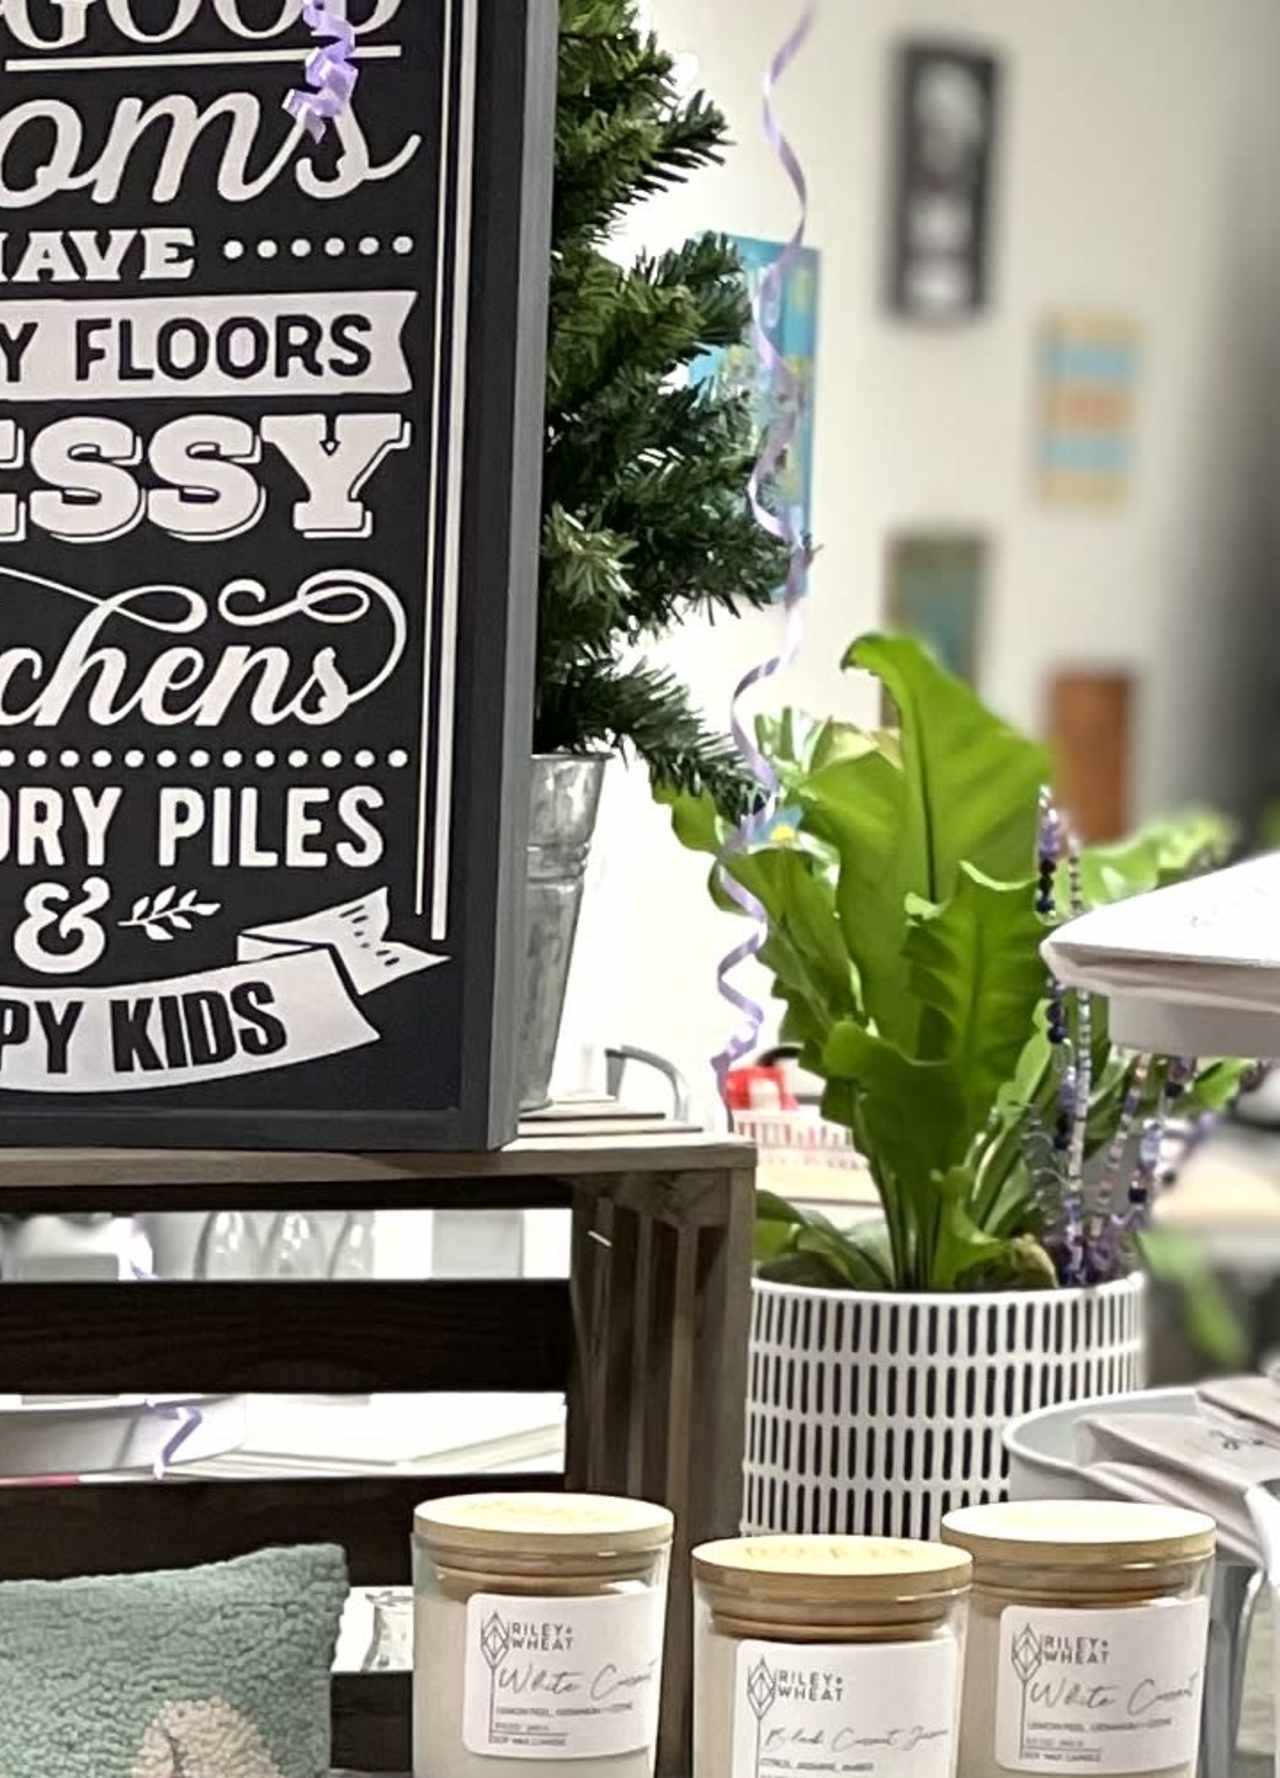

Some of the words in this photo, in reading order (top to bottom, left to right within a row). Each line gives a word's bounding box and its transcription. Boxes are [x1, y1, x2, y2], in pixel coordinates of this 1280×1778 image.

[74, 314, 372, 383] FLOORS
[157, 785, 385, 867] PILES
[13, 877, 111, 974] &
[110, 979, 288, 1073] KIDS
[511, 1636, 575, 1651] WHEAT
[1042, 1651, 1110, 1665] WHEAT
[778, 1687, 844, 1702] WHEAT
